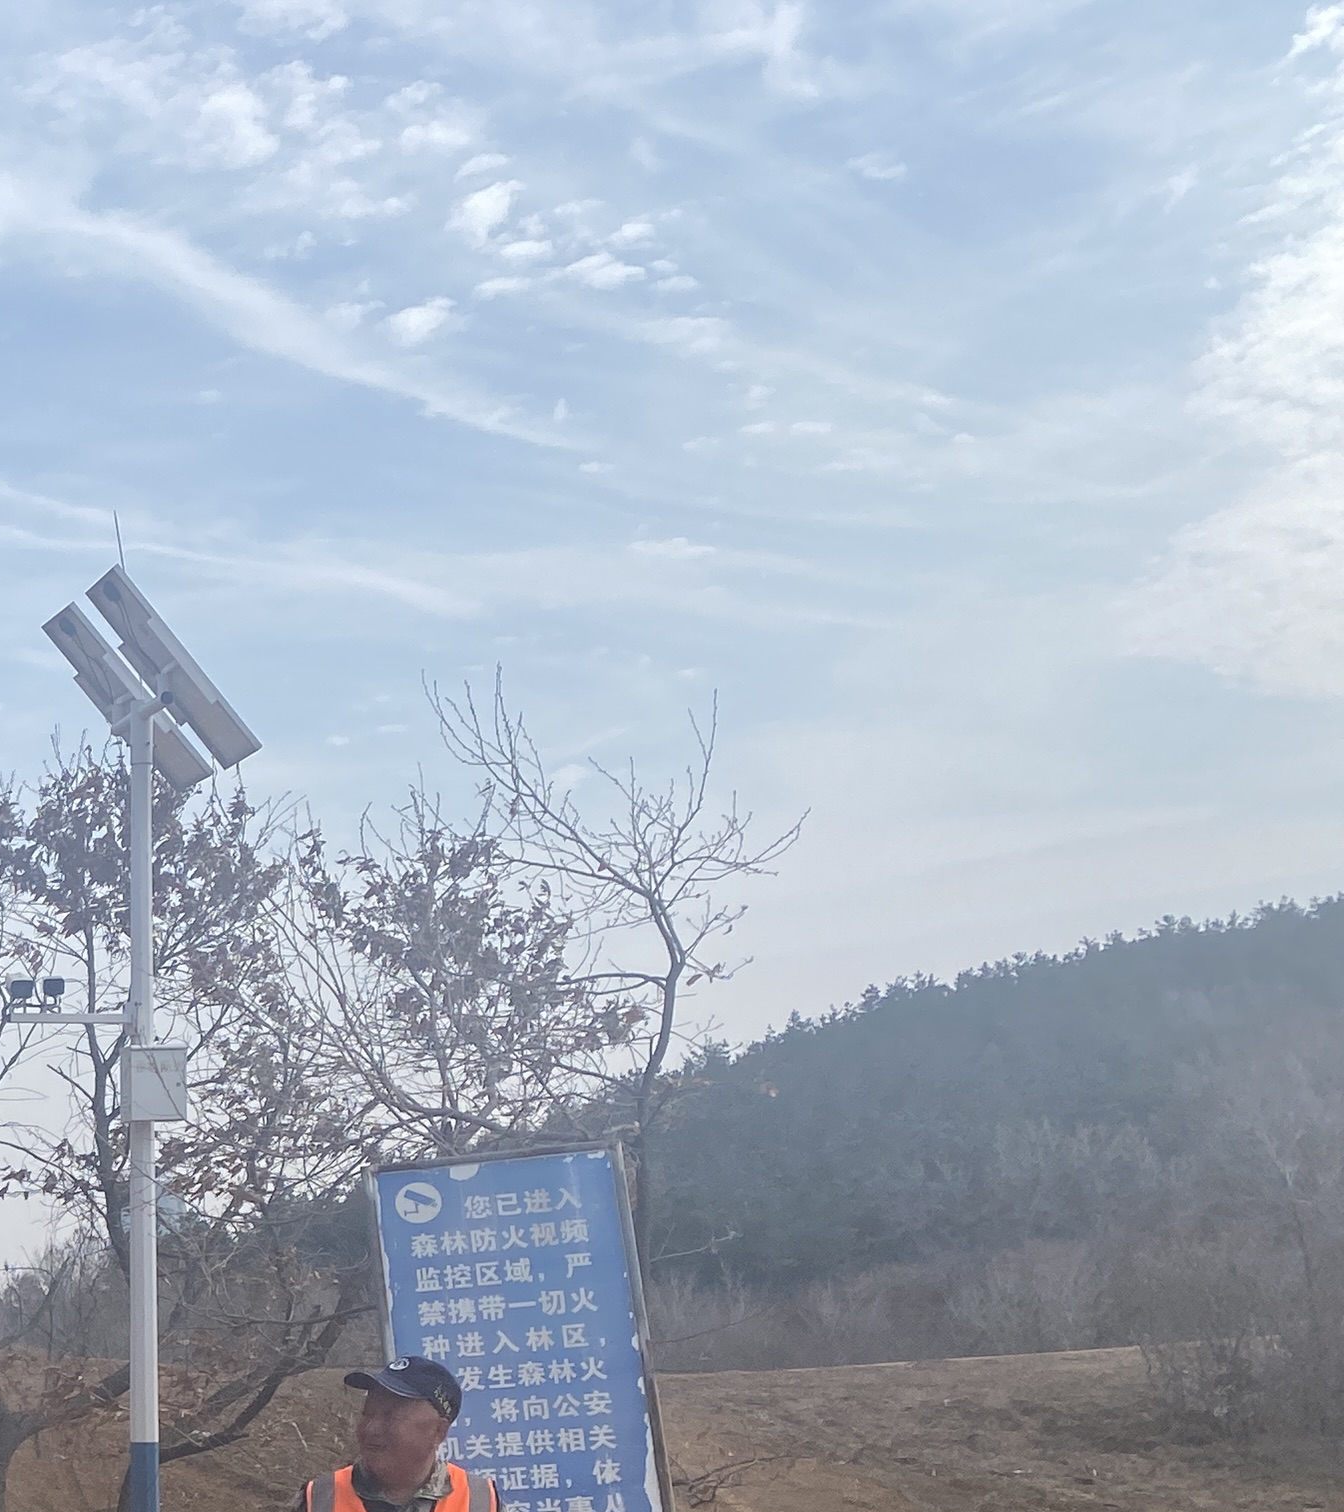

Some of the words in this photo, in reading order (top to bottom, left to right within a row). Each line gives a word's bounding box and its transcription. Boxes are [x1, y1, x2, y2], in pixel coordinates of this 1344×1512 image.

[464, 1187, 582, 1219] 您已进入
[411, 1218, 590, 1259] 森林防火视频
[415, 1252, 593, 1293] 监控区域，严
[418, 1287, 599, 1327] 禁携带一切火
[421, 1323, 607, 1360] 种进入林区，
[456, 1357, 608, 1392] 发生森林火
[450, 1390, 613, 1428] ，将向公安
[436, 1424, 618, 1462] 机关提供相关
